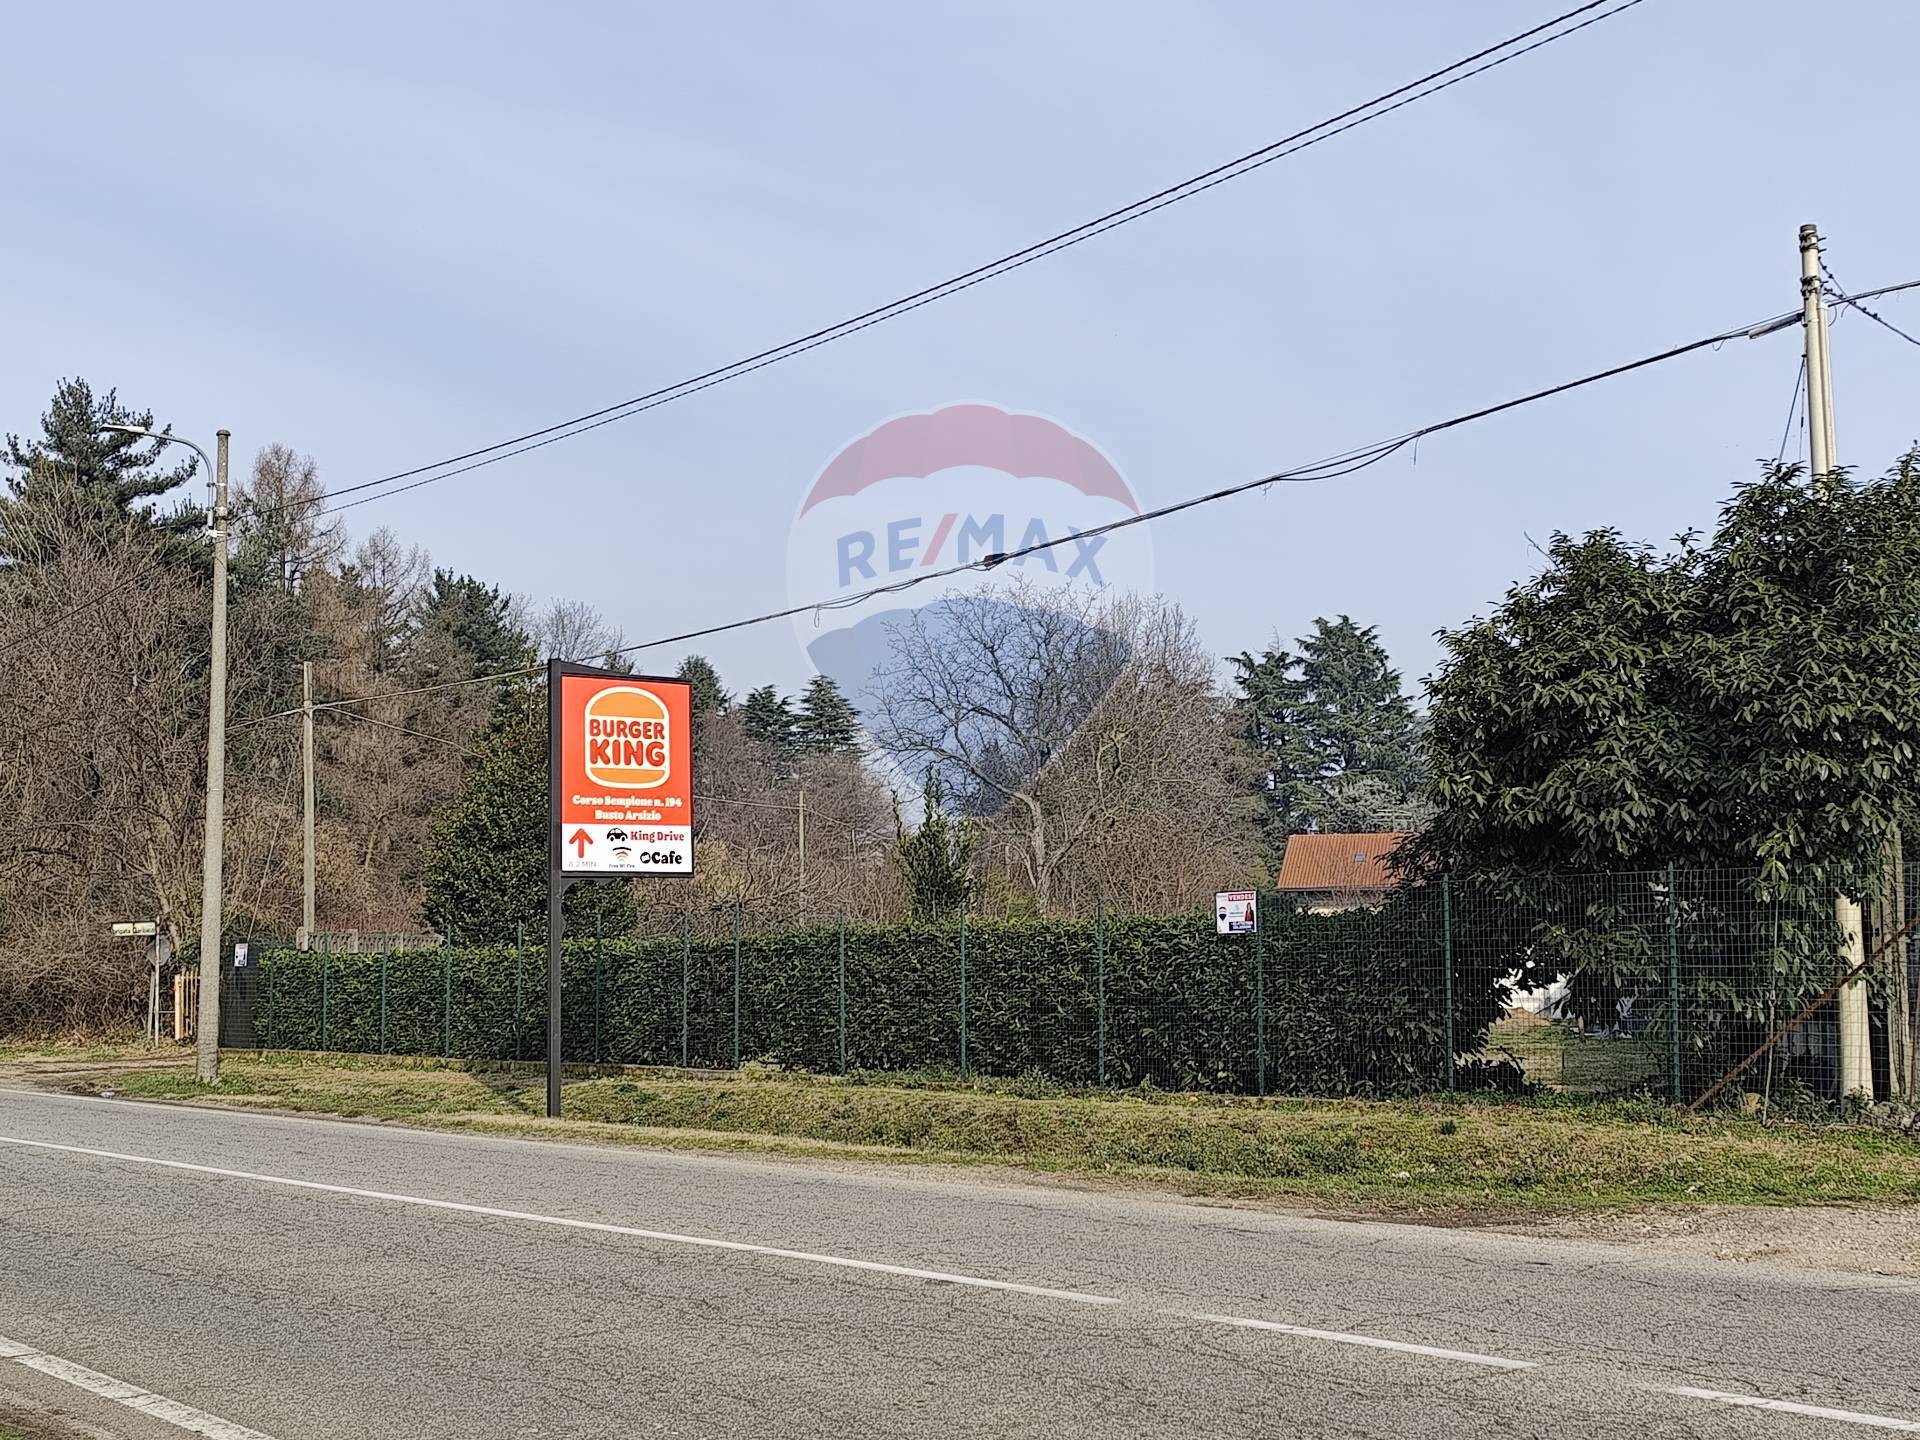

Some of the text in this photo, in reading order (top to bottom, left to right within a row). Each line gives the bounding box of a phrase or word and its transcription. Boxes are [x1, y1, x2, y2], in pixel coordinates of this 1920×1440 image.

[589, 718, 665, 740] BURGER
[589, 738, 666, 767] KING
[572, 794, 683, 809] Corso Sempione n. 194
[594, 809, 662, 821] Busto Arsizio
[630, 830, 685, 844] King Drive
[651, 850, 683, 865] Cafe
